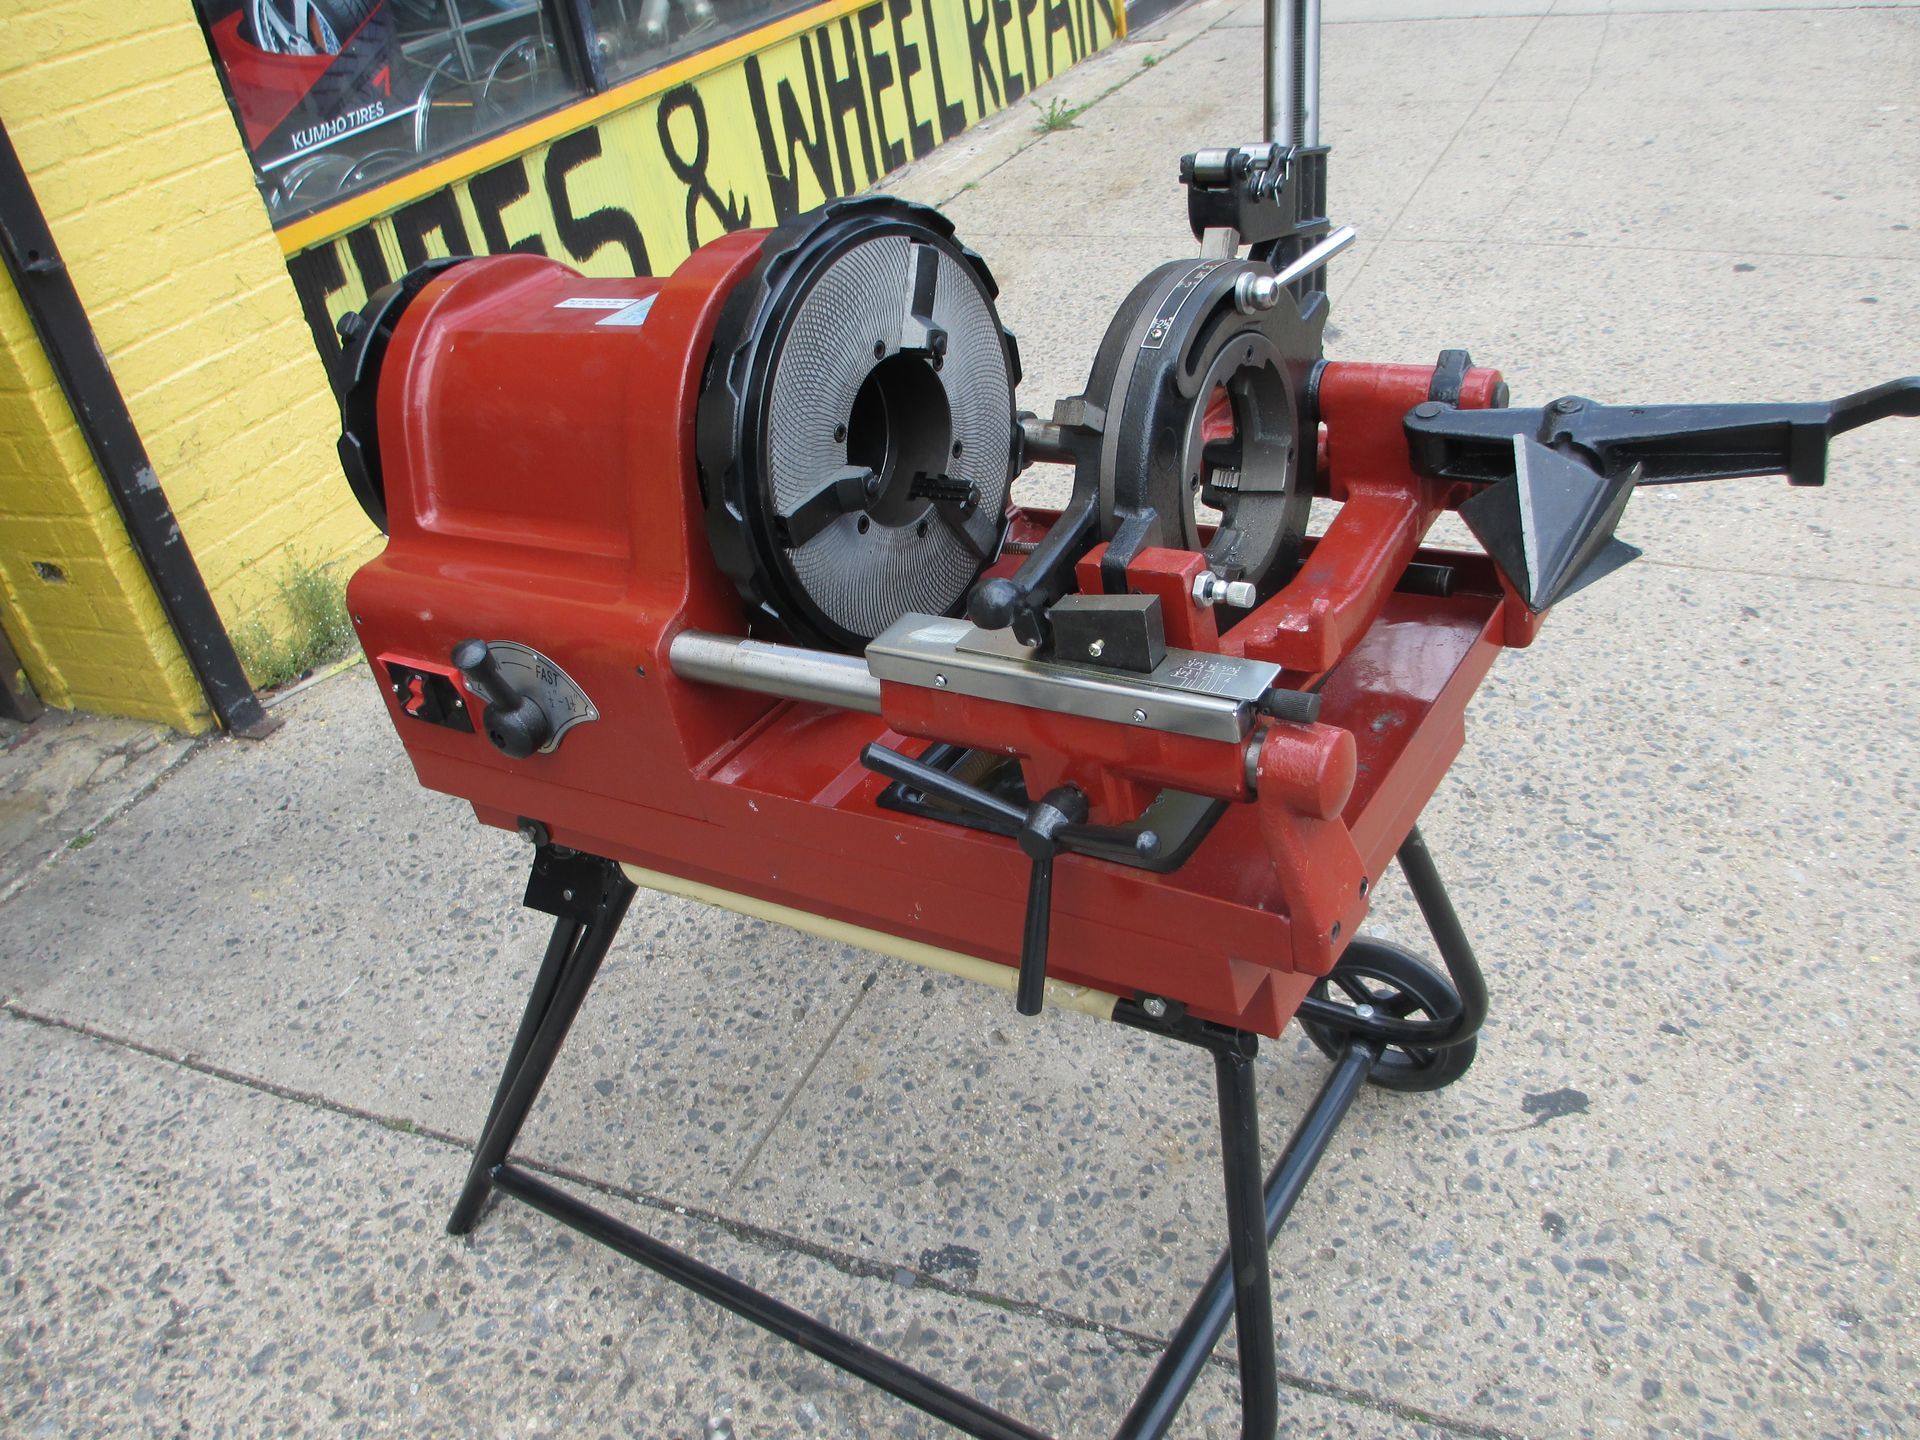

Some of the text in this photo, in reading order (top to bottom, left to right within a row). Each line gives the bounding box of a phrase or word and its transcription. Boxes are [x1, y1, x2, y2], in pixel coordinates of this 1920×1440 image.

[291, 101, 385, 151] KUMHO TIRES
[744, 0, 967, 228] WHEEL
[535, 664, 558, 687] FAST
